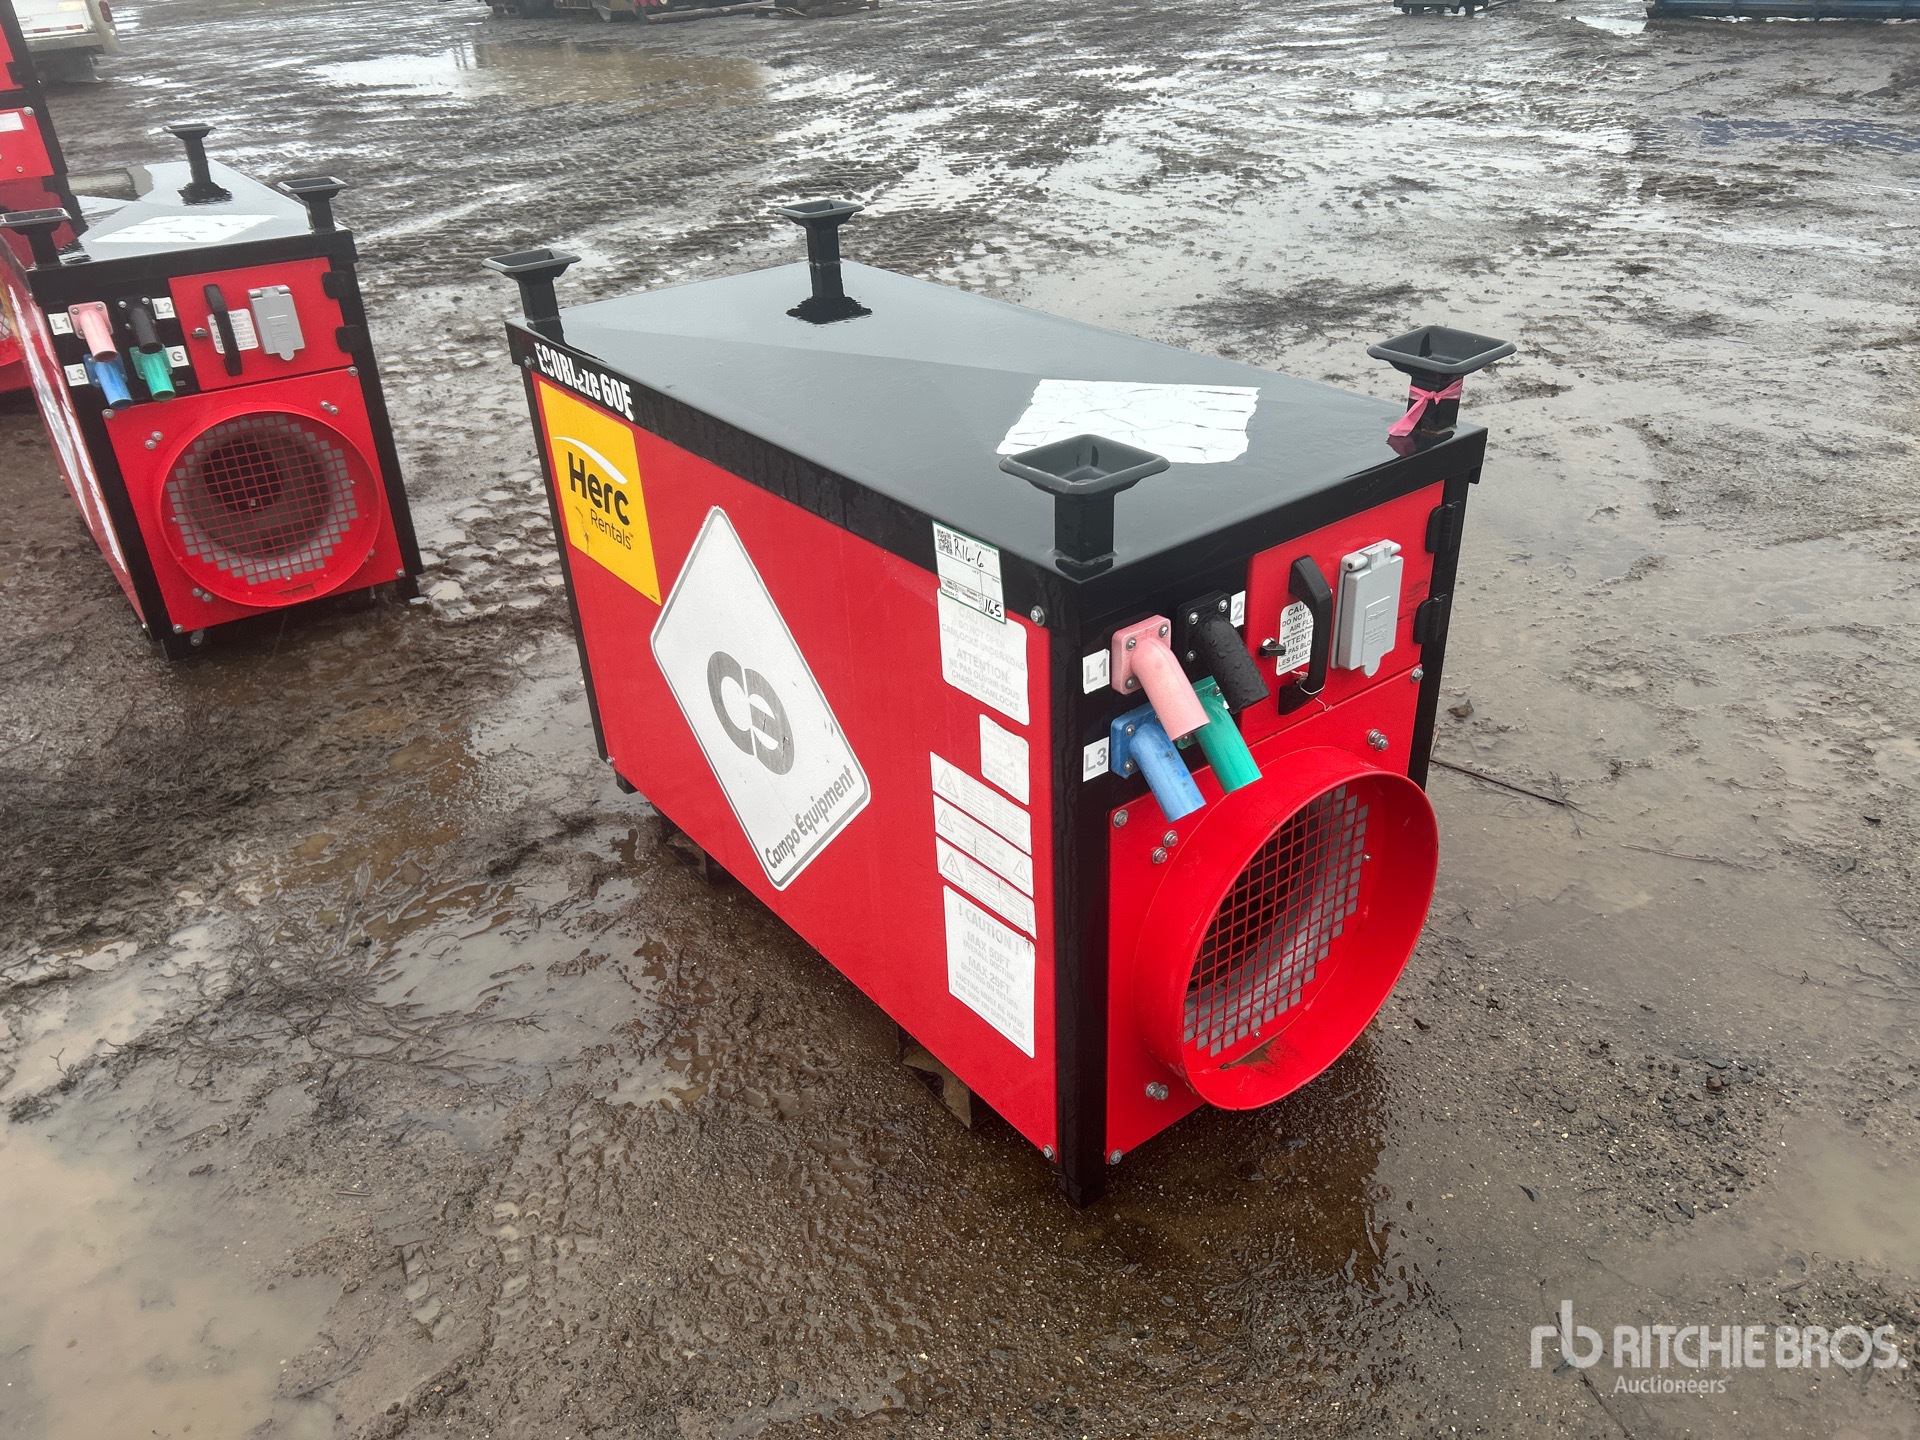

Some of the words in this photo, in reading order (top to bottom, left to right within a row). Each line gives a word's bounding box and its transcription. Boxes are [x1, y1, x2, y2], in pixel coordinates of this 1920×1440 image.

[154, 302, 173, 315] L2
[51, 317, 71, 330] L1
[172, 351, 184, 362] G
[67, 369, 86, 381] L3
[568, 451, 630, 526] Herc
[590, 508, 632, 551] Rentals
[1232, 601, 1244, 621] 2
[1282, 619, 1291, 627] DO
[1293, 612, 1306, 622] NOT
[1290, 622, 1301, 632] AIR
[1278, 657, 1290, 667] LES
[1292, 649, 1309, 661] FLUX
[1288, 647, 1299, 655] PAS
[1086, 657, 1108, 685] L1
[1085, 747, 1108, 773] L3
[765, 823, 801, 869] Campo
[795, 764, 856, 836] Equipment
[965, 908, 1011, 949] CAUTION
[967, 931, 986, 951] MAX
[968, 956, 987, 977] MAX
[989, 972, 1010, 995] 25FT
